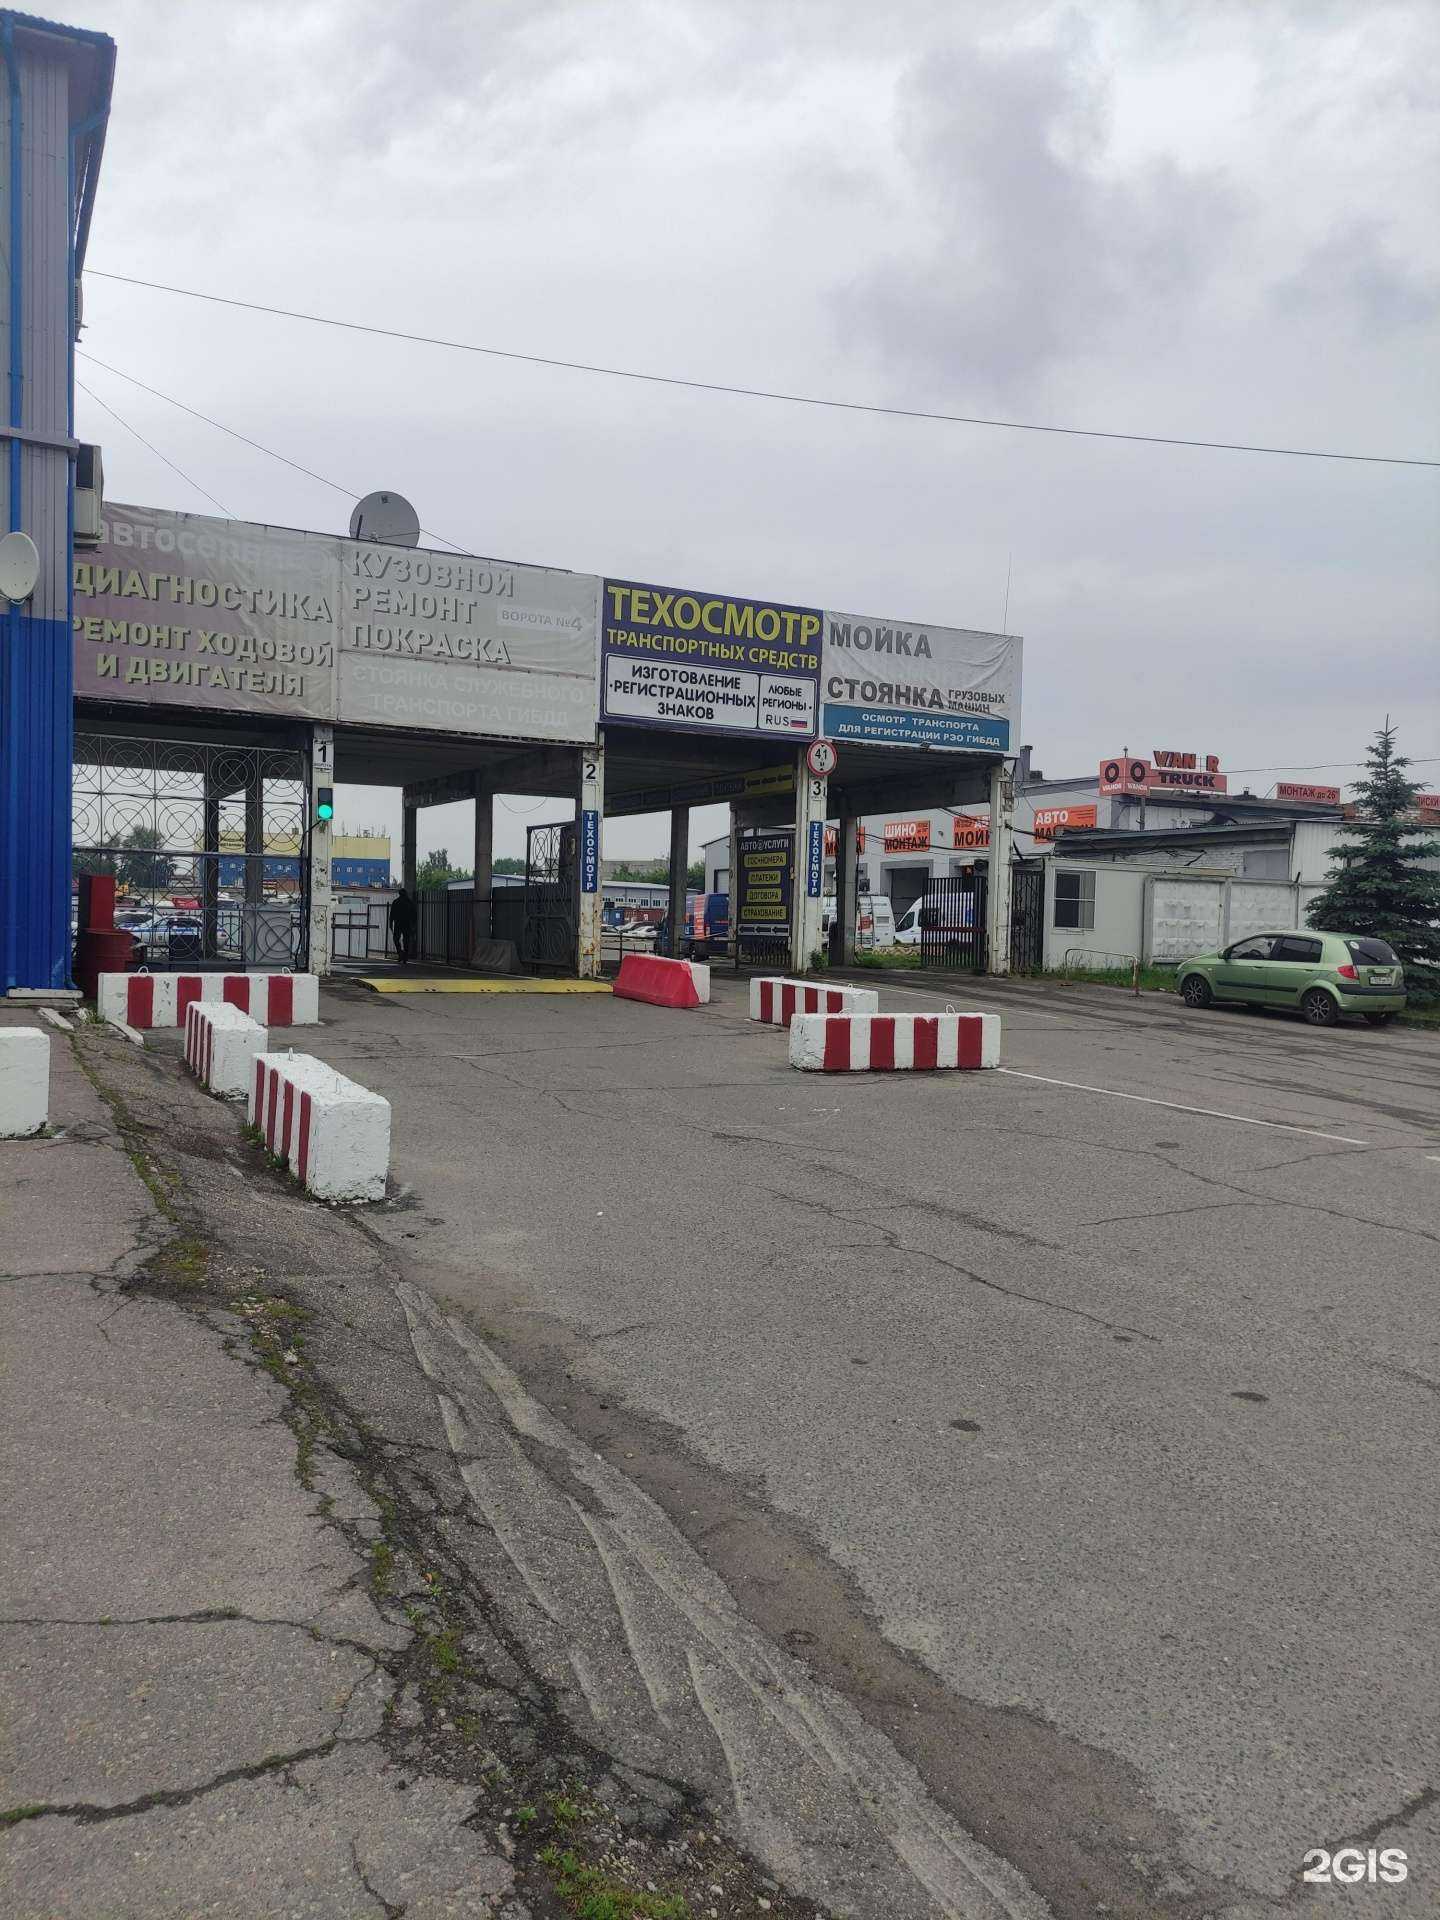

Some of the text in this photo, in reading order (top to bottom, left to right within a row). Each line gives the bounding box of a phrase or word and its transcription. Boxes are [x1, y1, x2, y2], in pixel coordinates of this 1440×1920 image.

[353, 551, 515, 598] КУЗОВНОЙ
[73, 562, 333, 624] ДИАГНОСТИКА
[353, 586, 478, 625] РЕМОНТ
[502, 610, 553, 625] ВОРОТА
[607, 585, 820, 646] ТЕХОСМОТР
[197, 630, 334, 667] ХОДОВОЙ
[352, 624, 511, 664] ПОКРАСКА
[606, 628, 818, 670] ТРАНСПОРТНЫХ СРЕДСТВ
[830, 622, 932, 659] МОЙКА
[97, 653, 304, 697] И ДВИГАТЕЛЯ
[353, 665, 584, 703] СТОЯНКА СЛУЖЕБНОГО
[632, 665, 741, 690] ИЗГОТОВЛЕНИЕ
[768, 685, 802, 697] ЛЮБЫЕ
[827, 676, 1005, 710] СТОЯНКА ГРУЗОВЫХ
[369, 694, 500, 720] ТРАНСПОРТА
[657, 702, 714, 720] ЗНАКОВ
[765, 714, 789, 727] RUS
[862, 713, 980, 731] ОСМОТР ТРАНСПОРТА
[838, 724, 1000, 747] ДЛЯ РЕГИСТРАЦИИ РЭО ГИБДД
[318, 745, 327, 763] 1
[585, 763, 596, 780] 2
[1158, 771, 1216, 787] TRUCK
[813, 780, 821, 796] 3
[1278, 785, 1315, 799] МОНТАЖ
[1035, 810, 1069, 825] АВТО
[885, 823, 917, 838] ШИНО
[586, 812, 595, 891] ТЕХОСМОТР
[884, 836, 928, 851] МОНТАЖ
[811, 823, 820, 895] ТЕХОСМОТР
[743, 908, 784, 918] СТРАХОВАНИЕ
